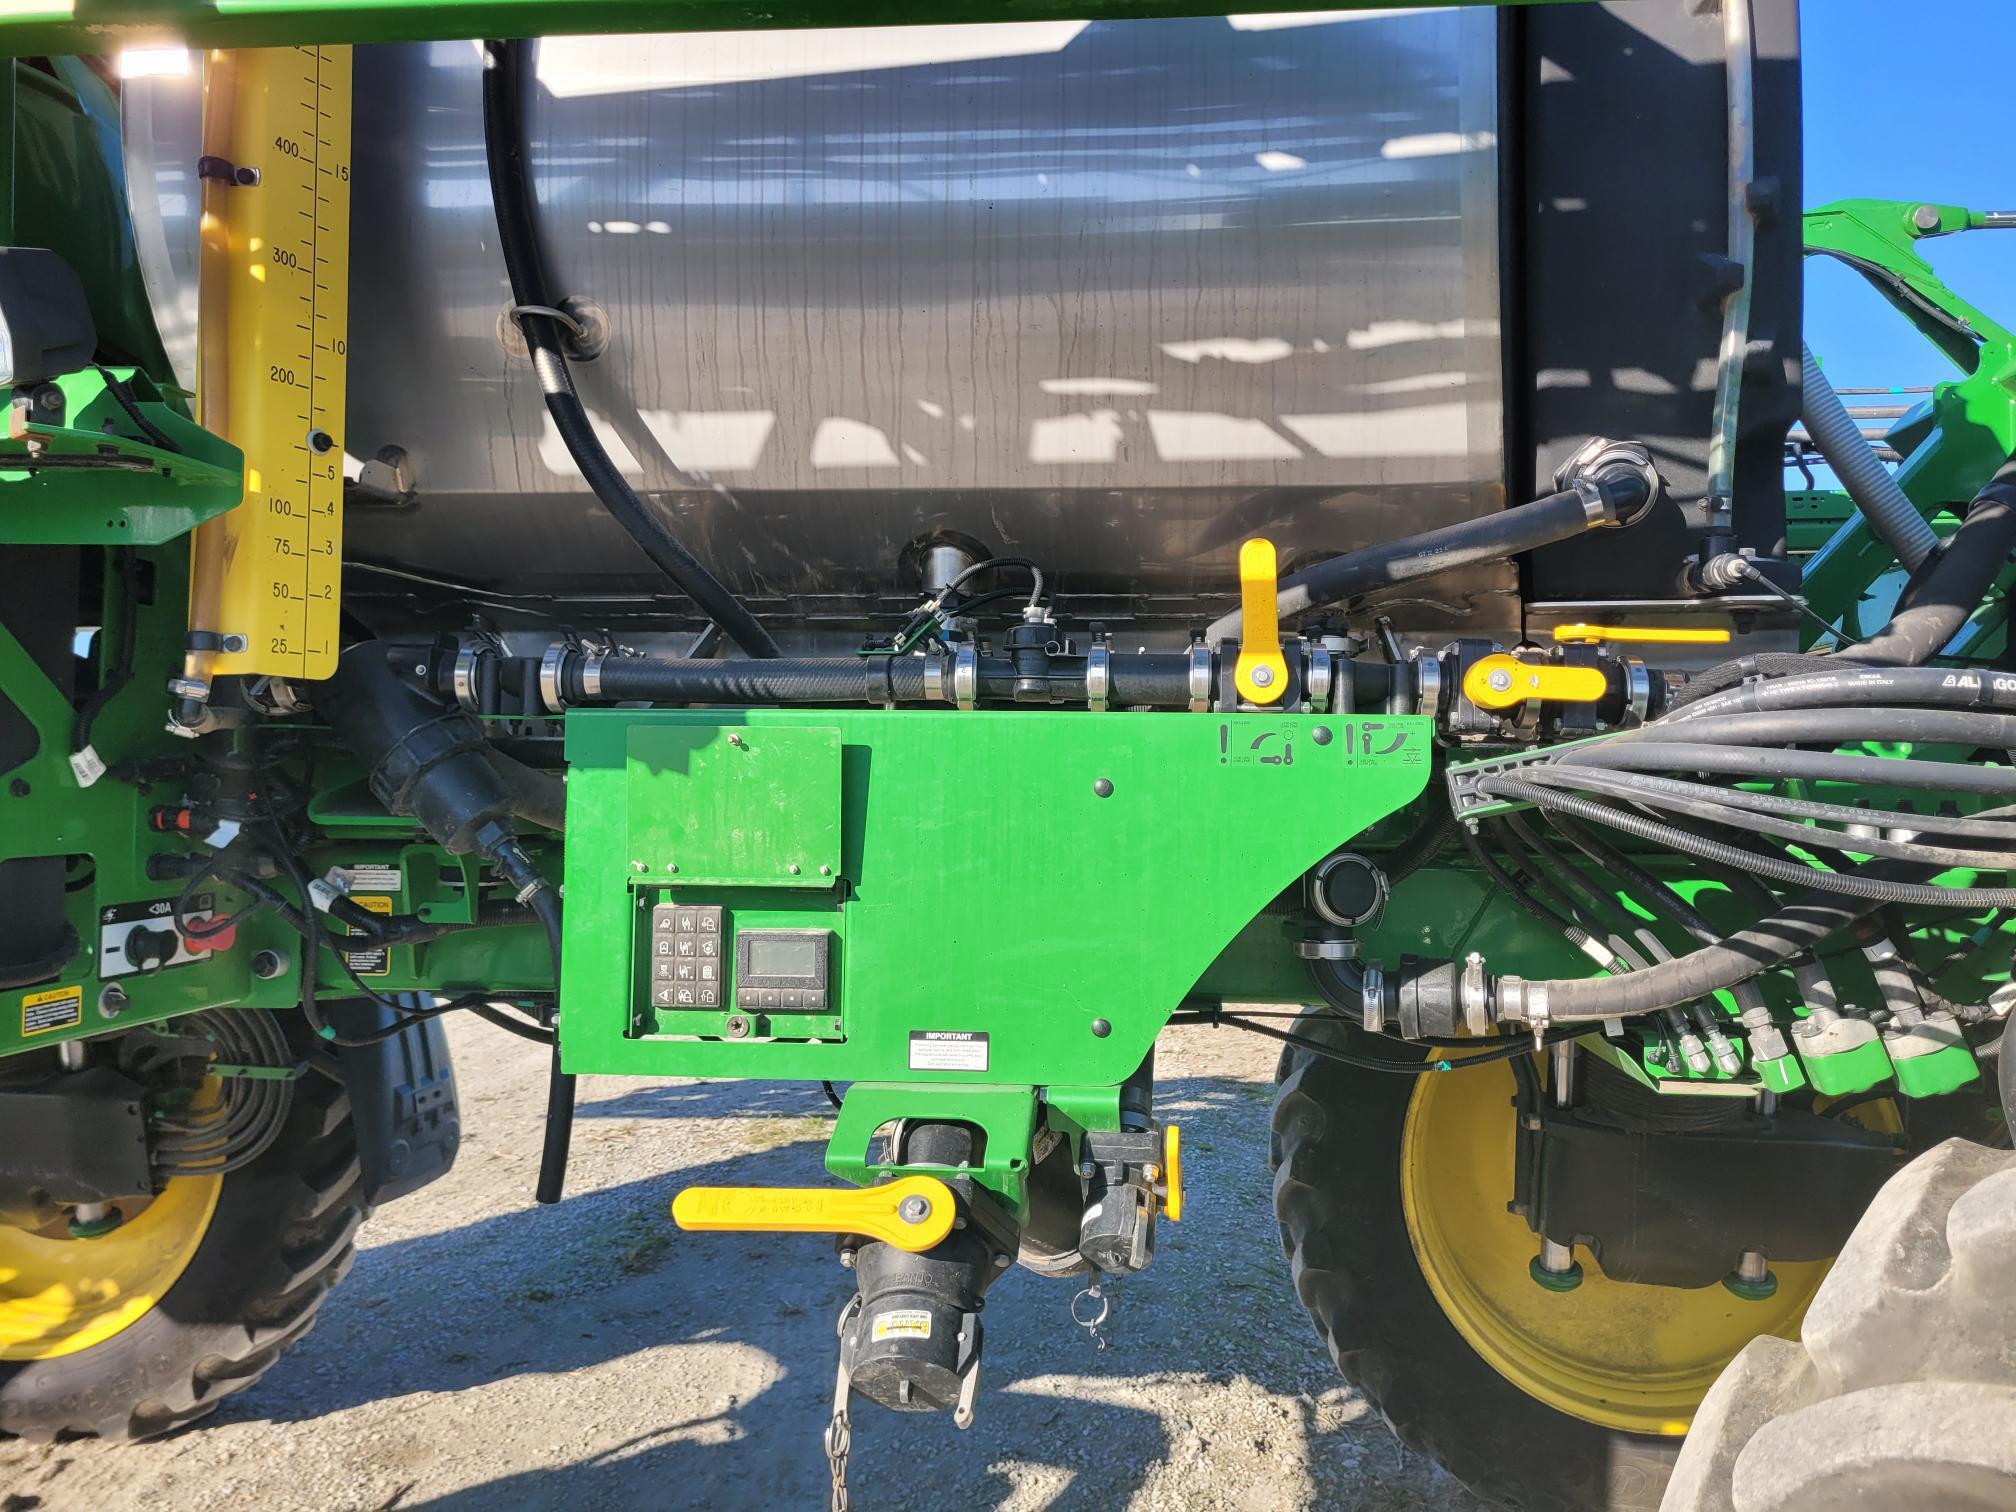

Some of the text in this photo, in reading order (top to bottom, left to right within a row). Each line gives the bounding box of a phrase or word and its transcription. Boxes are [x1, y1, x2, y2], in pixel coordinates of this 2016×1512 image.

[274, 136, 299, 158] 400
[335, 165, 349, 182] 15
[273, 247, 297, 269] 300
[330, 340, 346, 355] 10
[270, 366, 295, 386] 200
[327, 465, 335, 481] 5
[269, 497, 292, 516] 100
[326, 502, 334, 517] 4
[274, 538, 290, 555] 75
[325, 540, 333, 555] 3
[272, 583, 289, 599] 50
[324, 585, 332, 600] 2
[271, 638, 287, 654] 25
[324, 640, 328, 654] 1
[926, 1032, 972, 1040] IMPORTANT
[895, 1272, 933, 1283] BANJO
